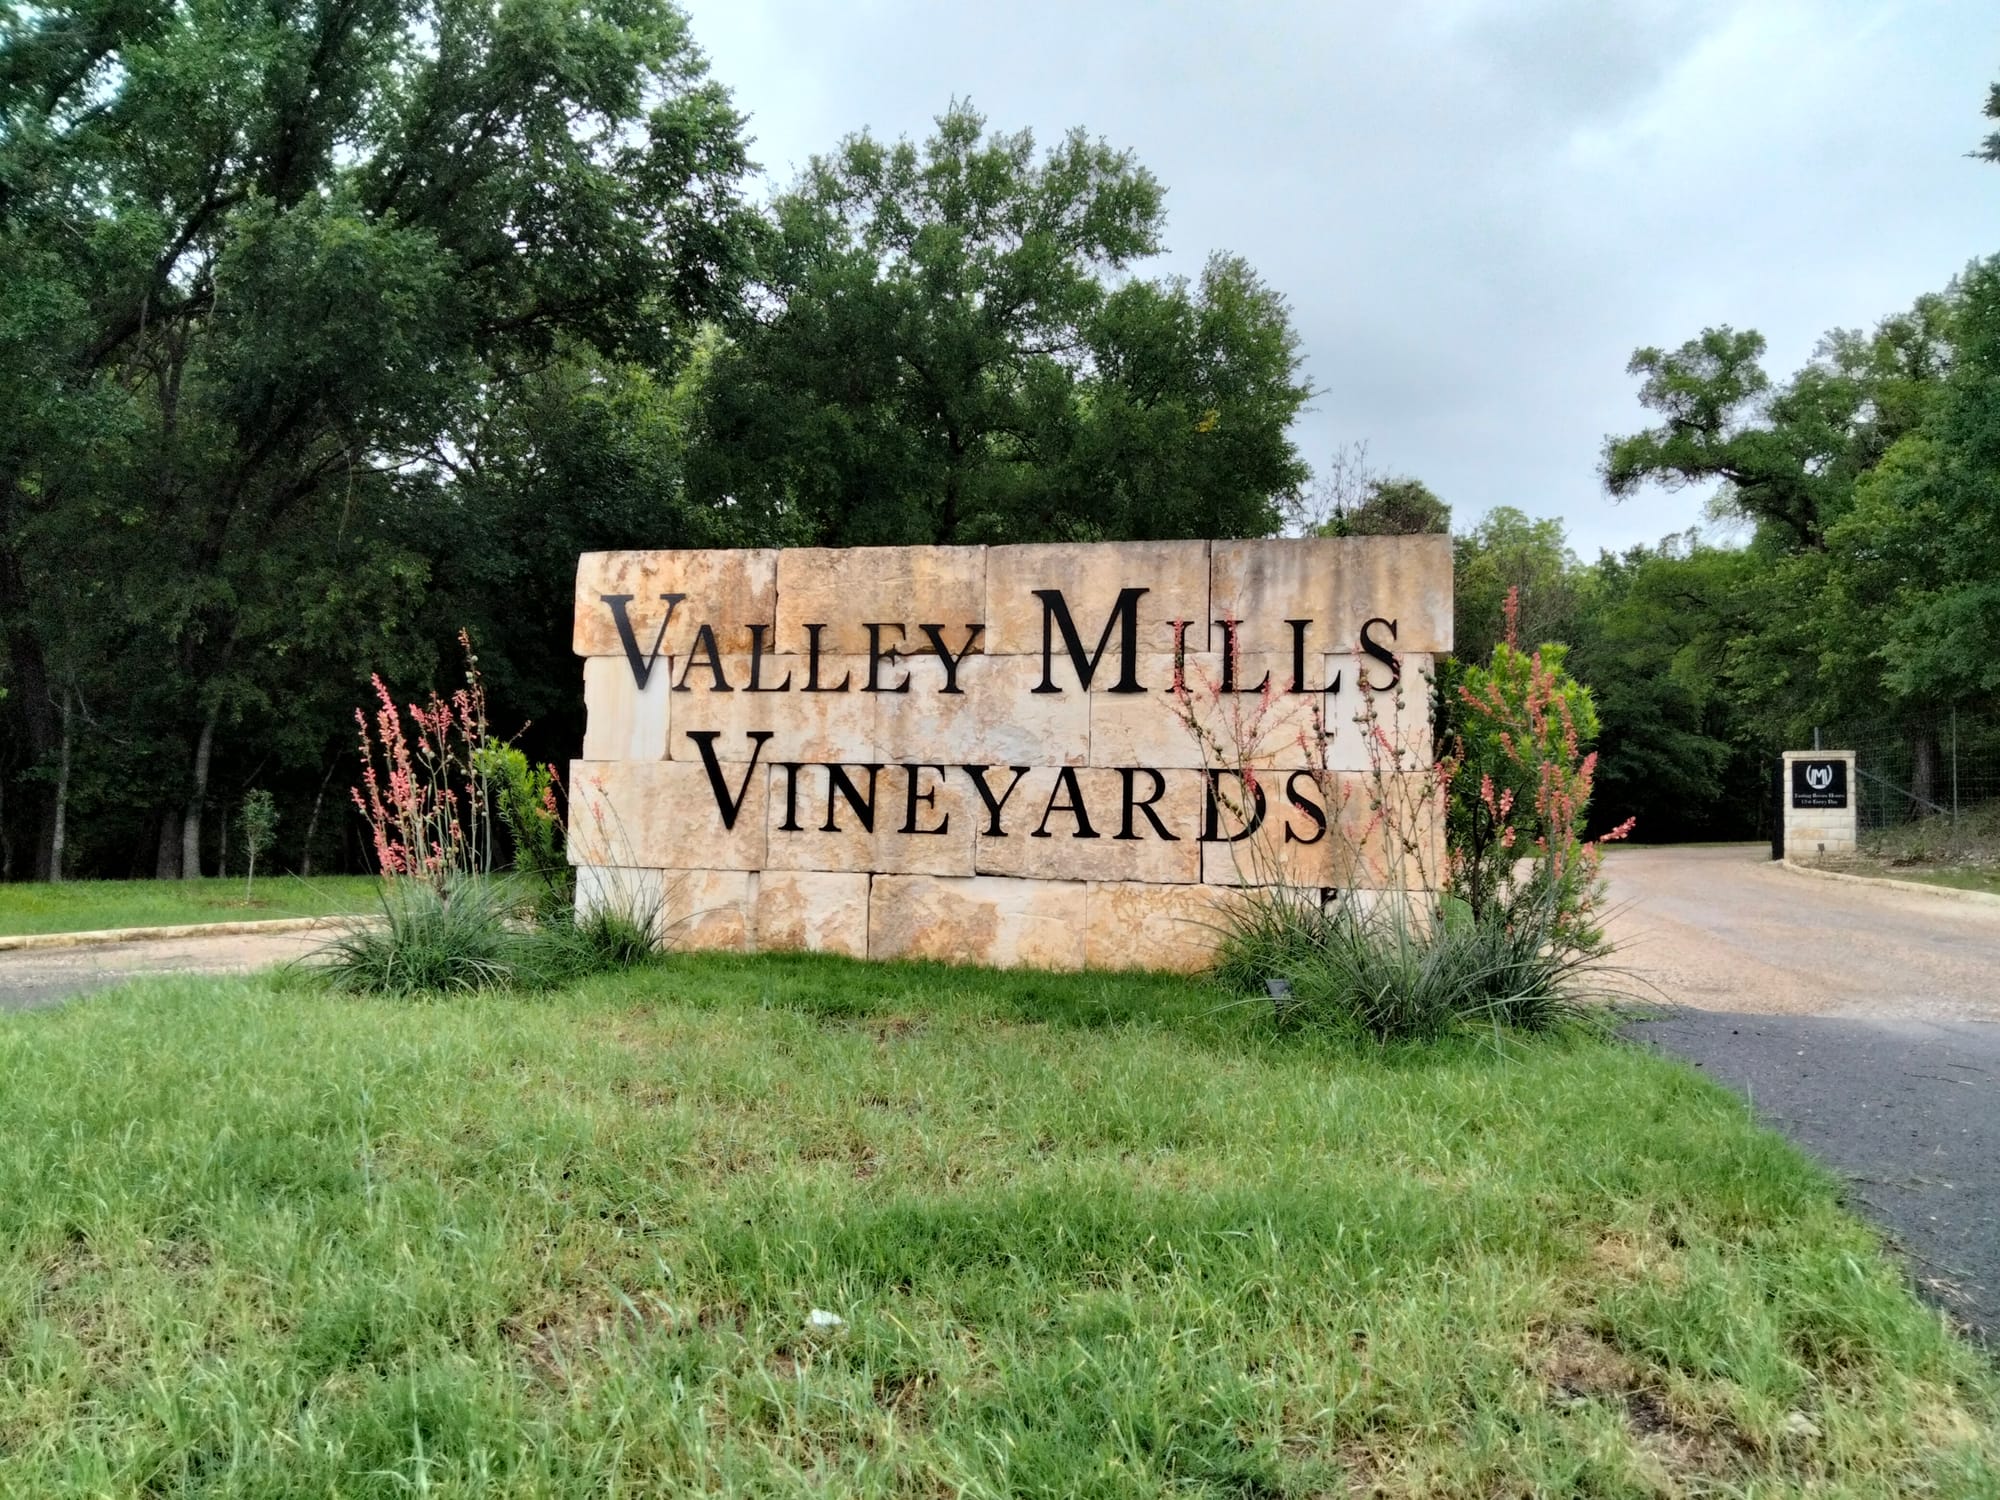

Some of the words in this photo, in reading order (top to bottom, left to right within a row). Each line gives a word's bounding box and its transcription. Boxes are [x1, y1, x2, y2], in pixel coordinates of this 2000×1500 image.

[600, 594, 986, 694] VALLEY
[1031, 588, 1402, 694] MILLS
[686, 731, 1328, 844] VINEYARDS
